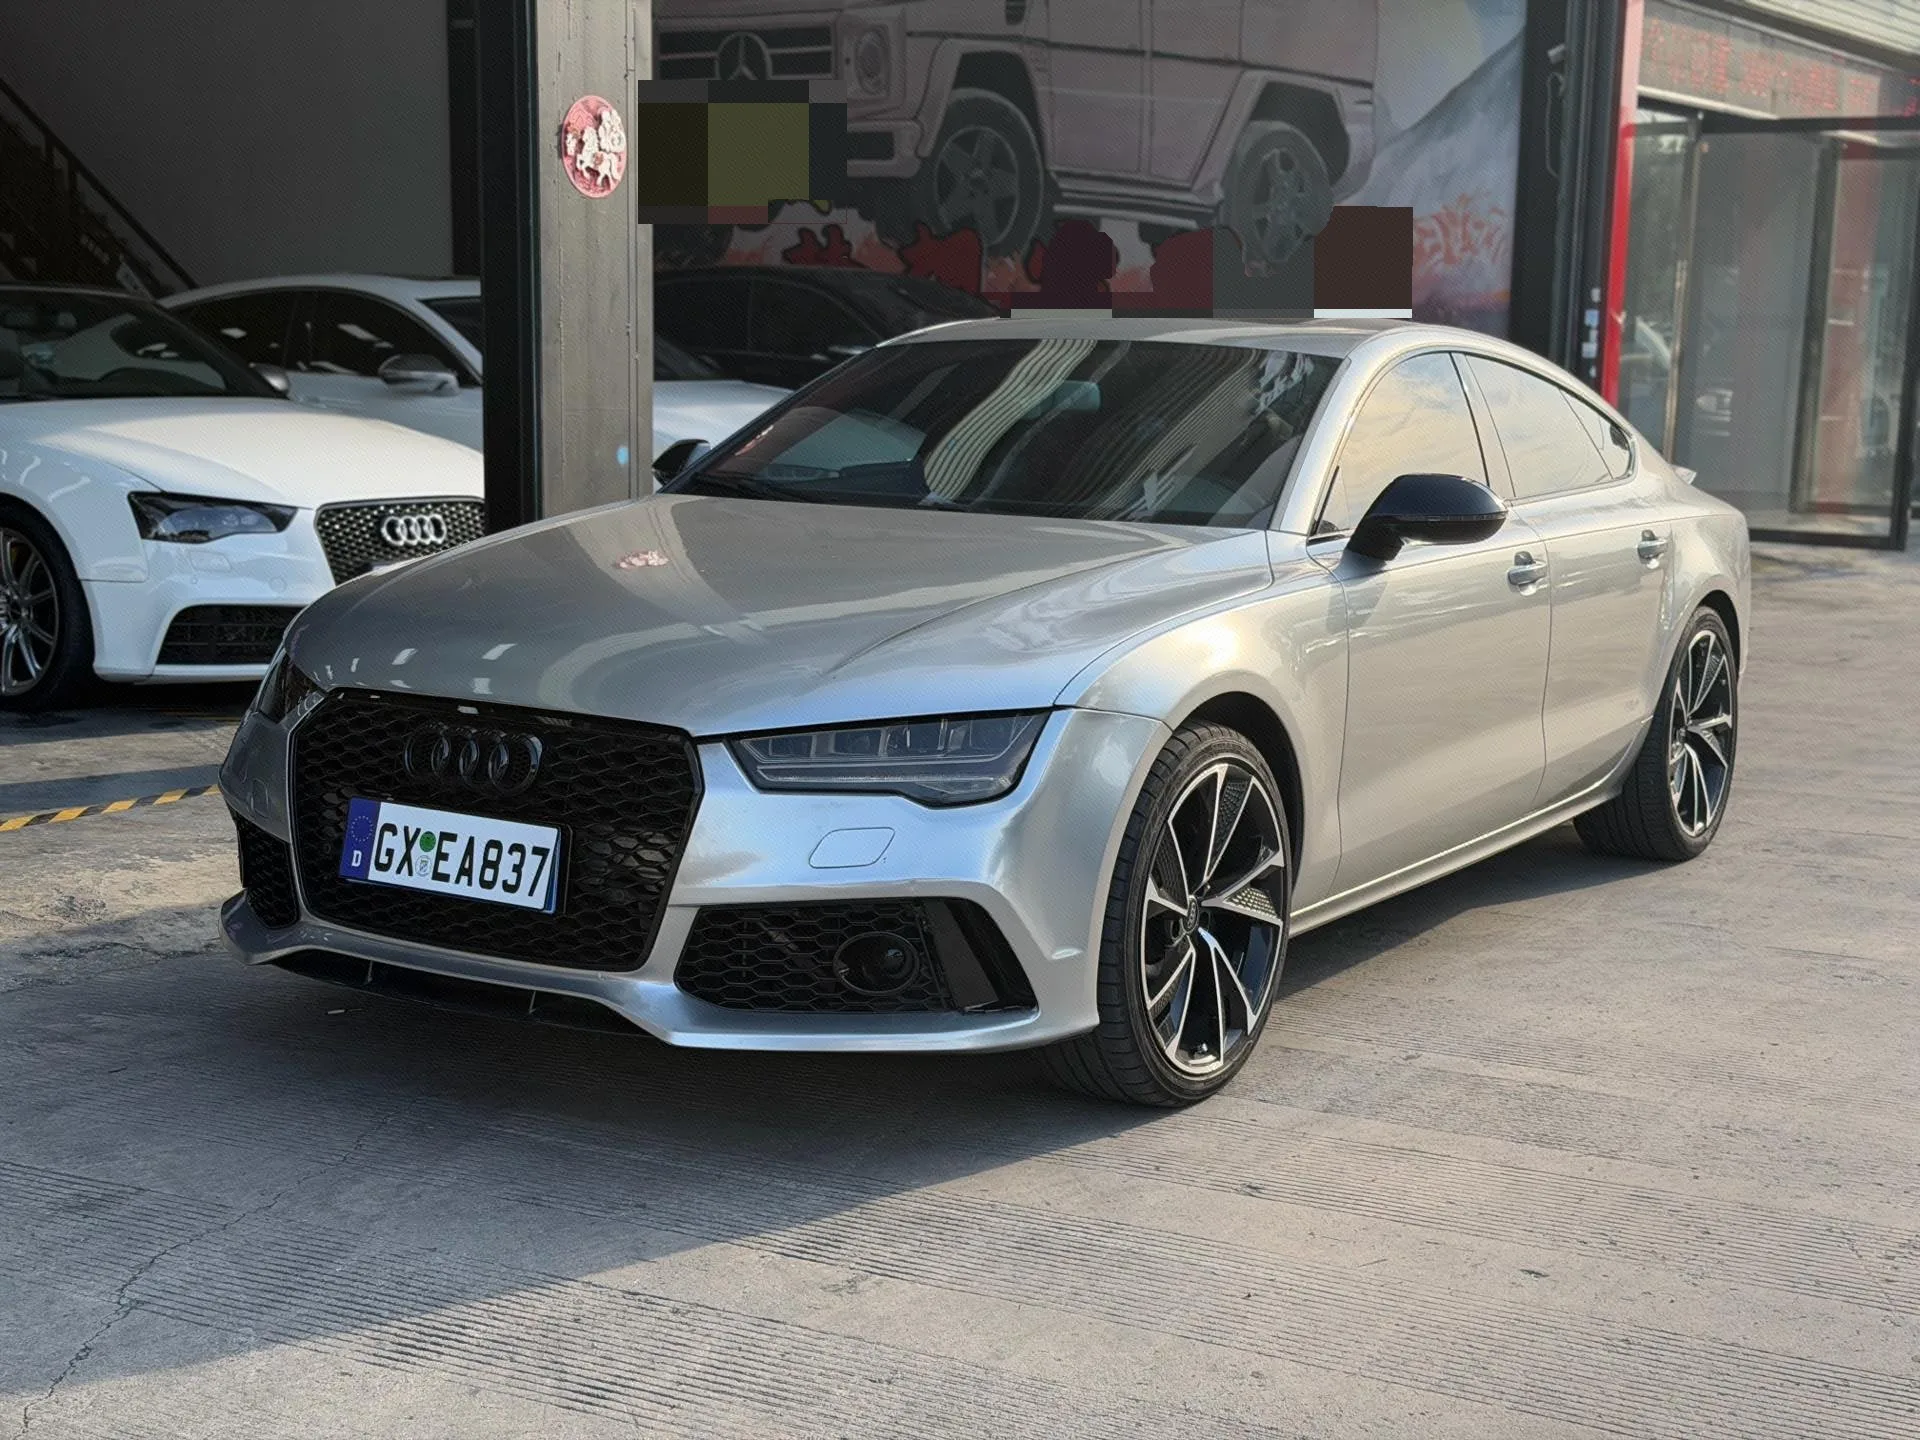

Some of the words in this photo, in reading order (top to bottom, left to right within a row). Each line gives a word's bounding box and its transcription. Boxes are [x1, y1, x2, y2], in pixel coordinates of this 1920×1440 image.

[351, 850, 362, 867] D
[374, 823, 421, 877] GX
[431, 831, 551, 897] EA837
